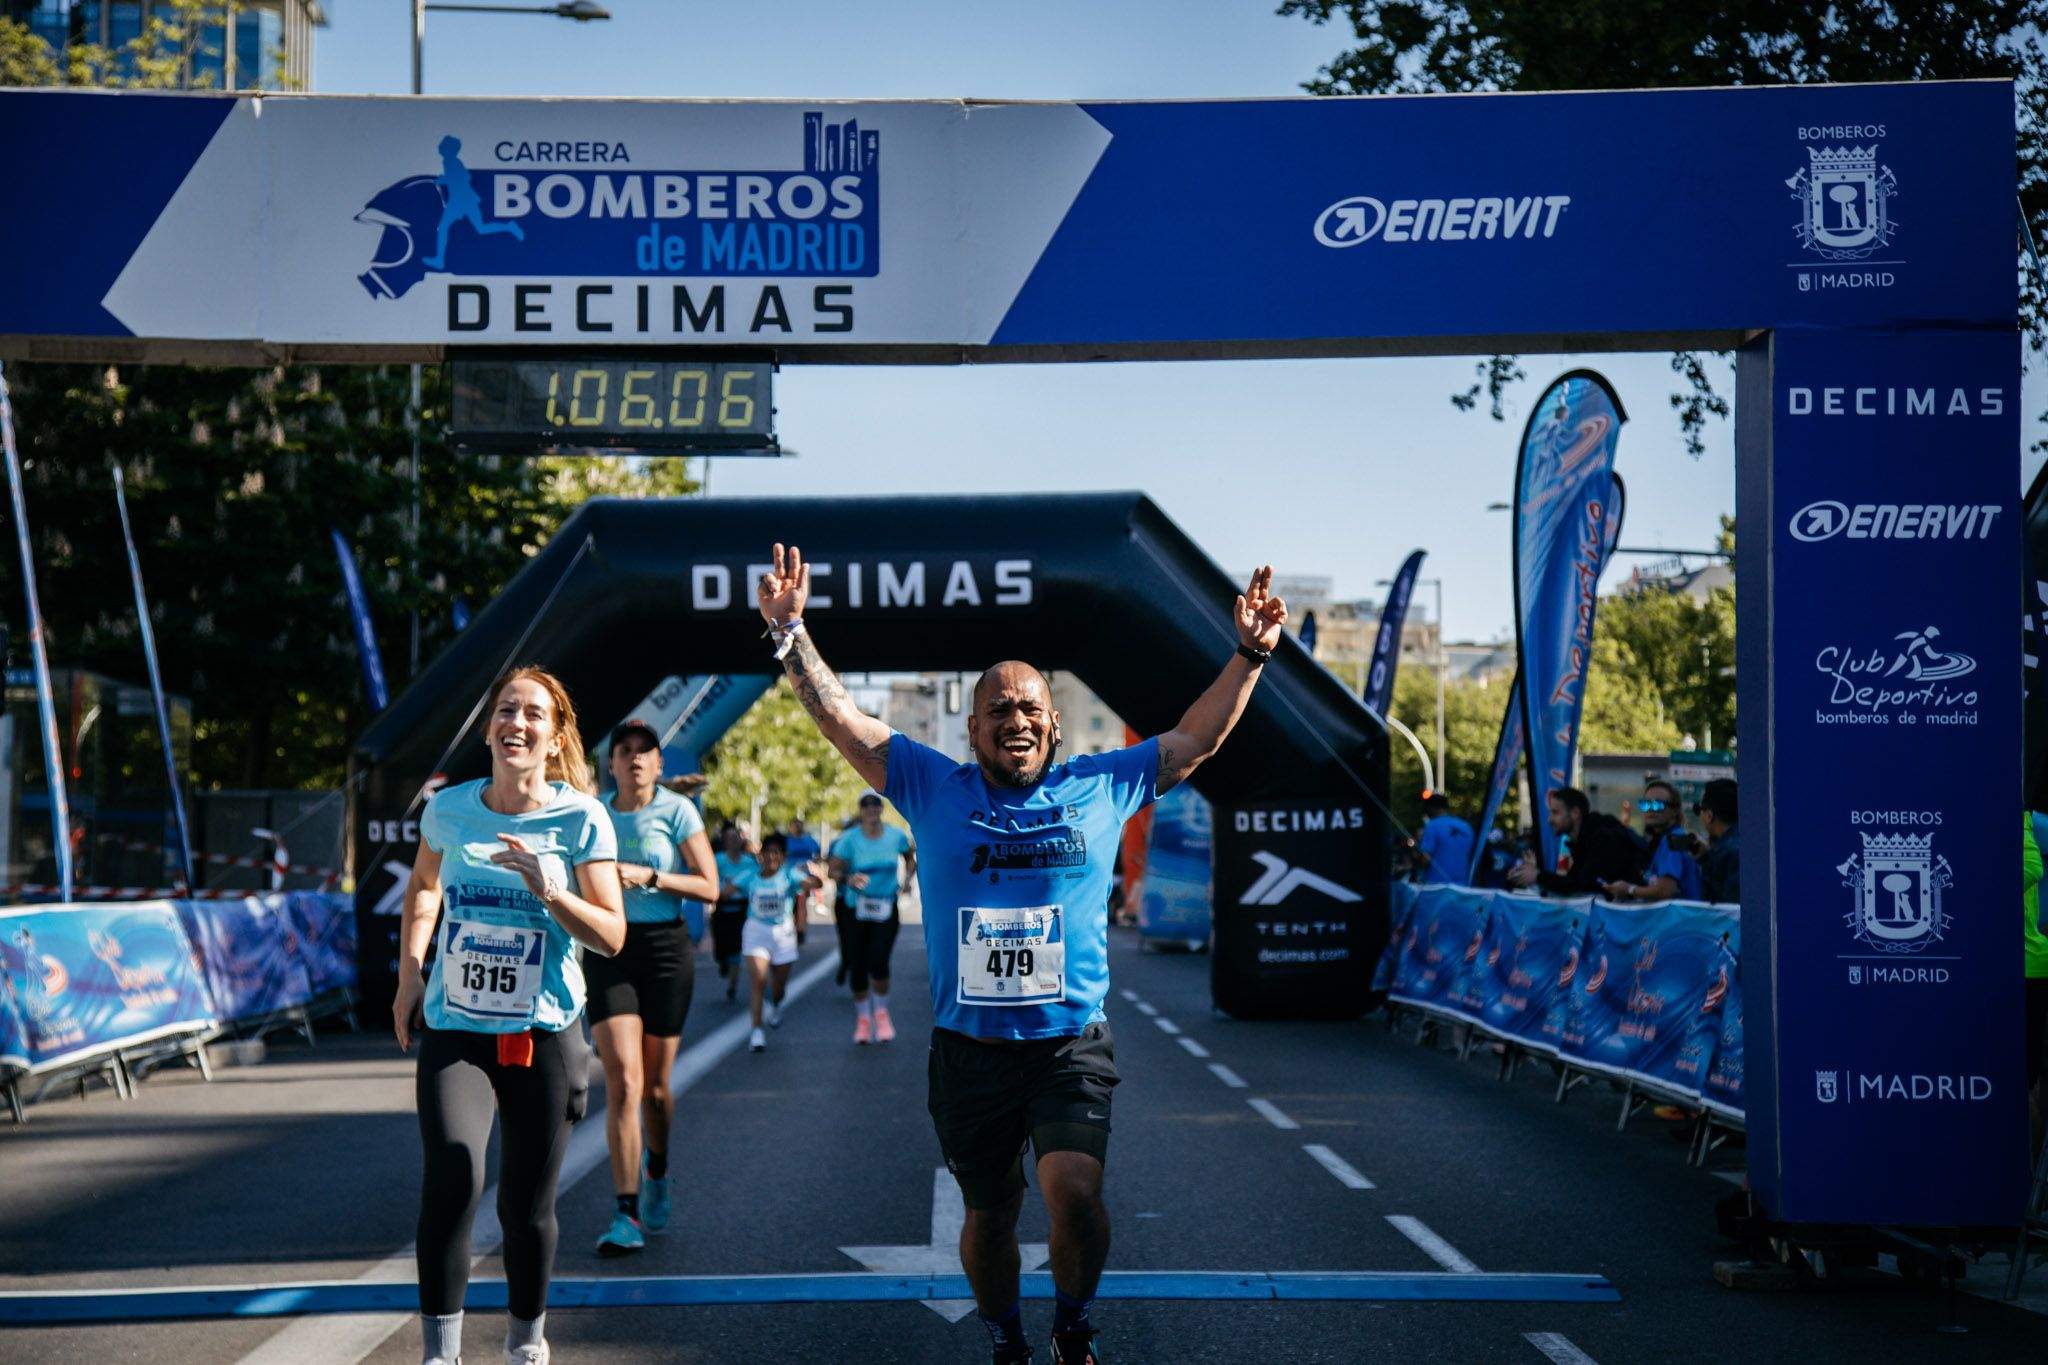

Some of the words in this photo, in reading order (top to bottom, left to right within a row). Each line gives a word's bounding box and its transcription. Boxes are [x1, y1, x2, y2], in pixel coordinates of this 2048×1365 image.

[1797, 124, 1887, 140] BOMBEROS
[494, 141, 630, 163] CARRERA
[493, 173, 864, 220] BOMBEROS
[1383, 196, 1571, 242] ENERVIT
[636, 222, 687, 271] de
[701, 222, 866, 272] MADRID
[1821, 271, 1896, 289] MADRID
[447, 283, 855, 333] DECIMAS
[1788, 387, 2004, 416] DECIMAS
[1846, 504, 2003, 540] ENERVIT
[1816, 645, 1886, 676] Club
[1830, 671, 1979, 713] Deportivo
[1816, 711, 1889, 725] bomberos
[1898, 711, 1917, 725] de
[1926, 711, 1978, 725] madrid
[1234, 807, 1364, 833] DECIMAS
[1850, 810, 1944, 826] BOMBEROS
[1256, 920, 1347, 936] TENTH
[985, 937, 1042, 948] DECIMAS
[467, 951, 521, 965] DECIMAS
[986, 948, 1034, 978] 479
[461, 961, 517, 994] 1315
[1873, 966, 1949, 984] MADRID
[1859, 1074, 1993, 1101] MADRID
